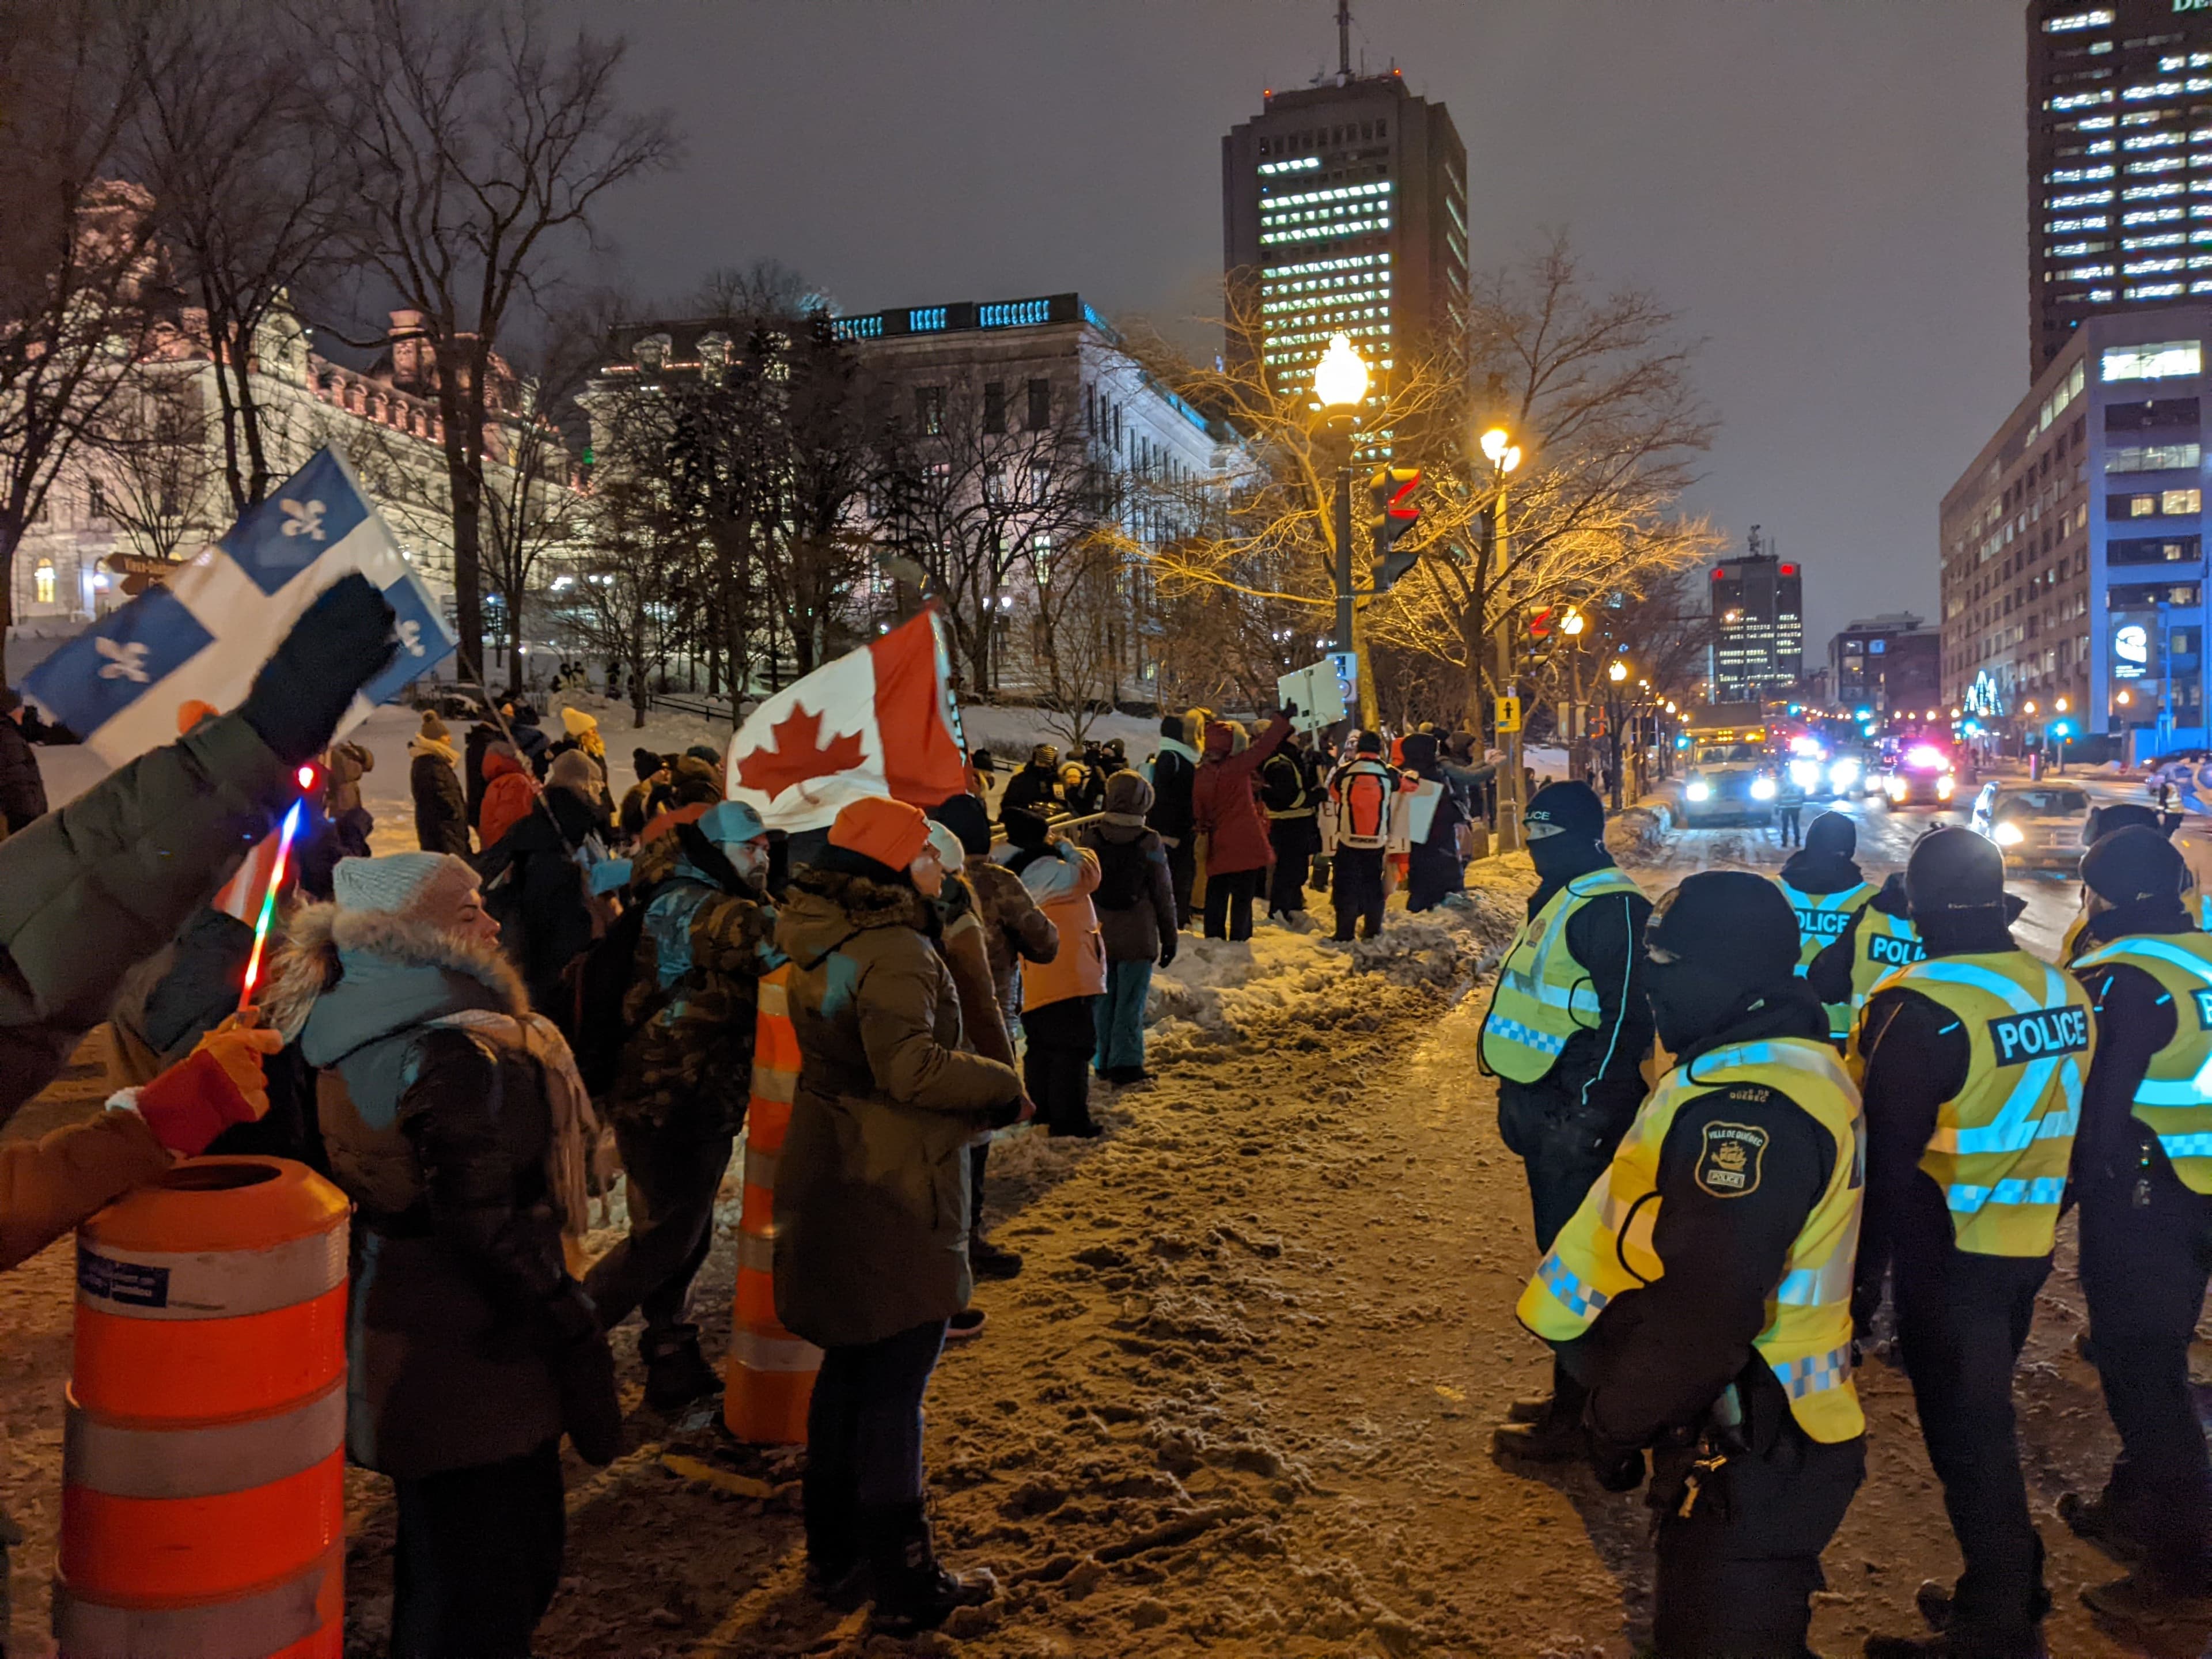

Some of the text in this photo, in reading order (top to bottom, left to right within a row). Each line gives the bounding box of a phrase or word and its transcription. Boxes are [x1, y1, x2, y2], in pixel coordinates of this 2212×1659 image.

[1997, 1011, 2086, 1059] POLICE
[1709, 1130, 1763, 1147] VILLE DE QUÉBEC
